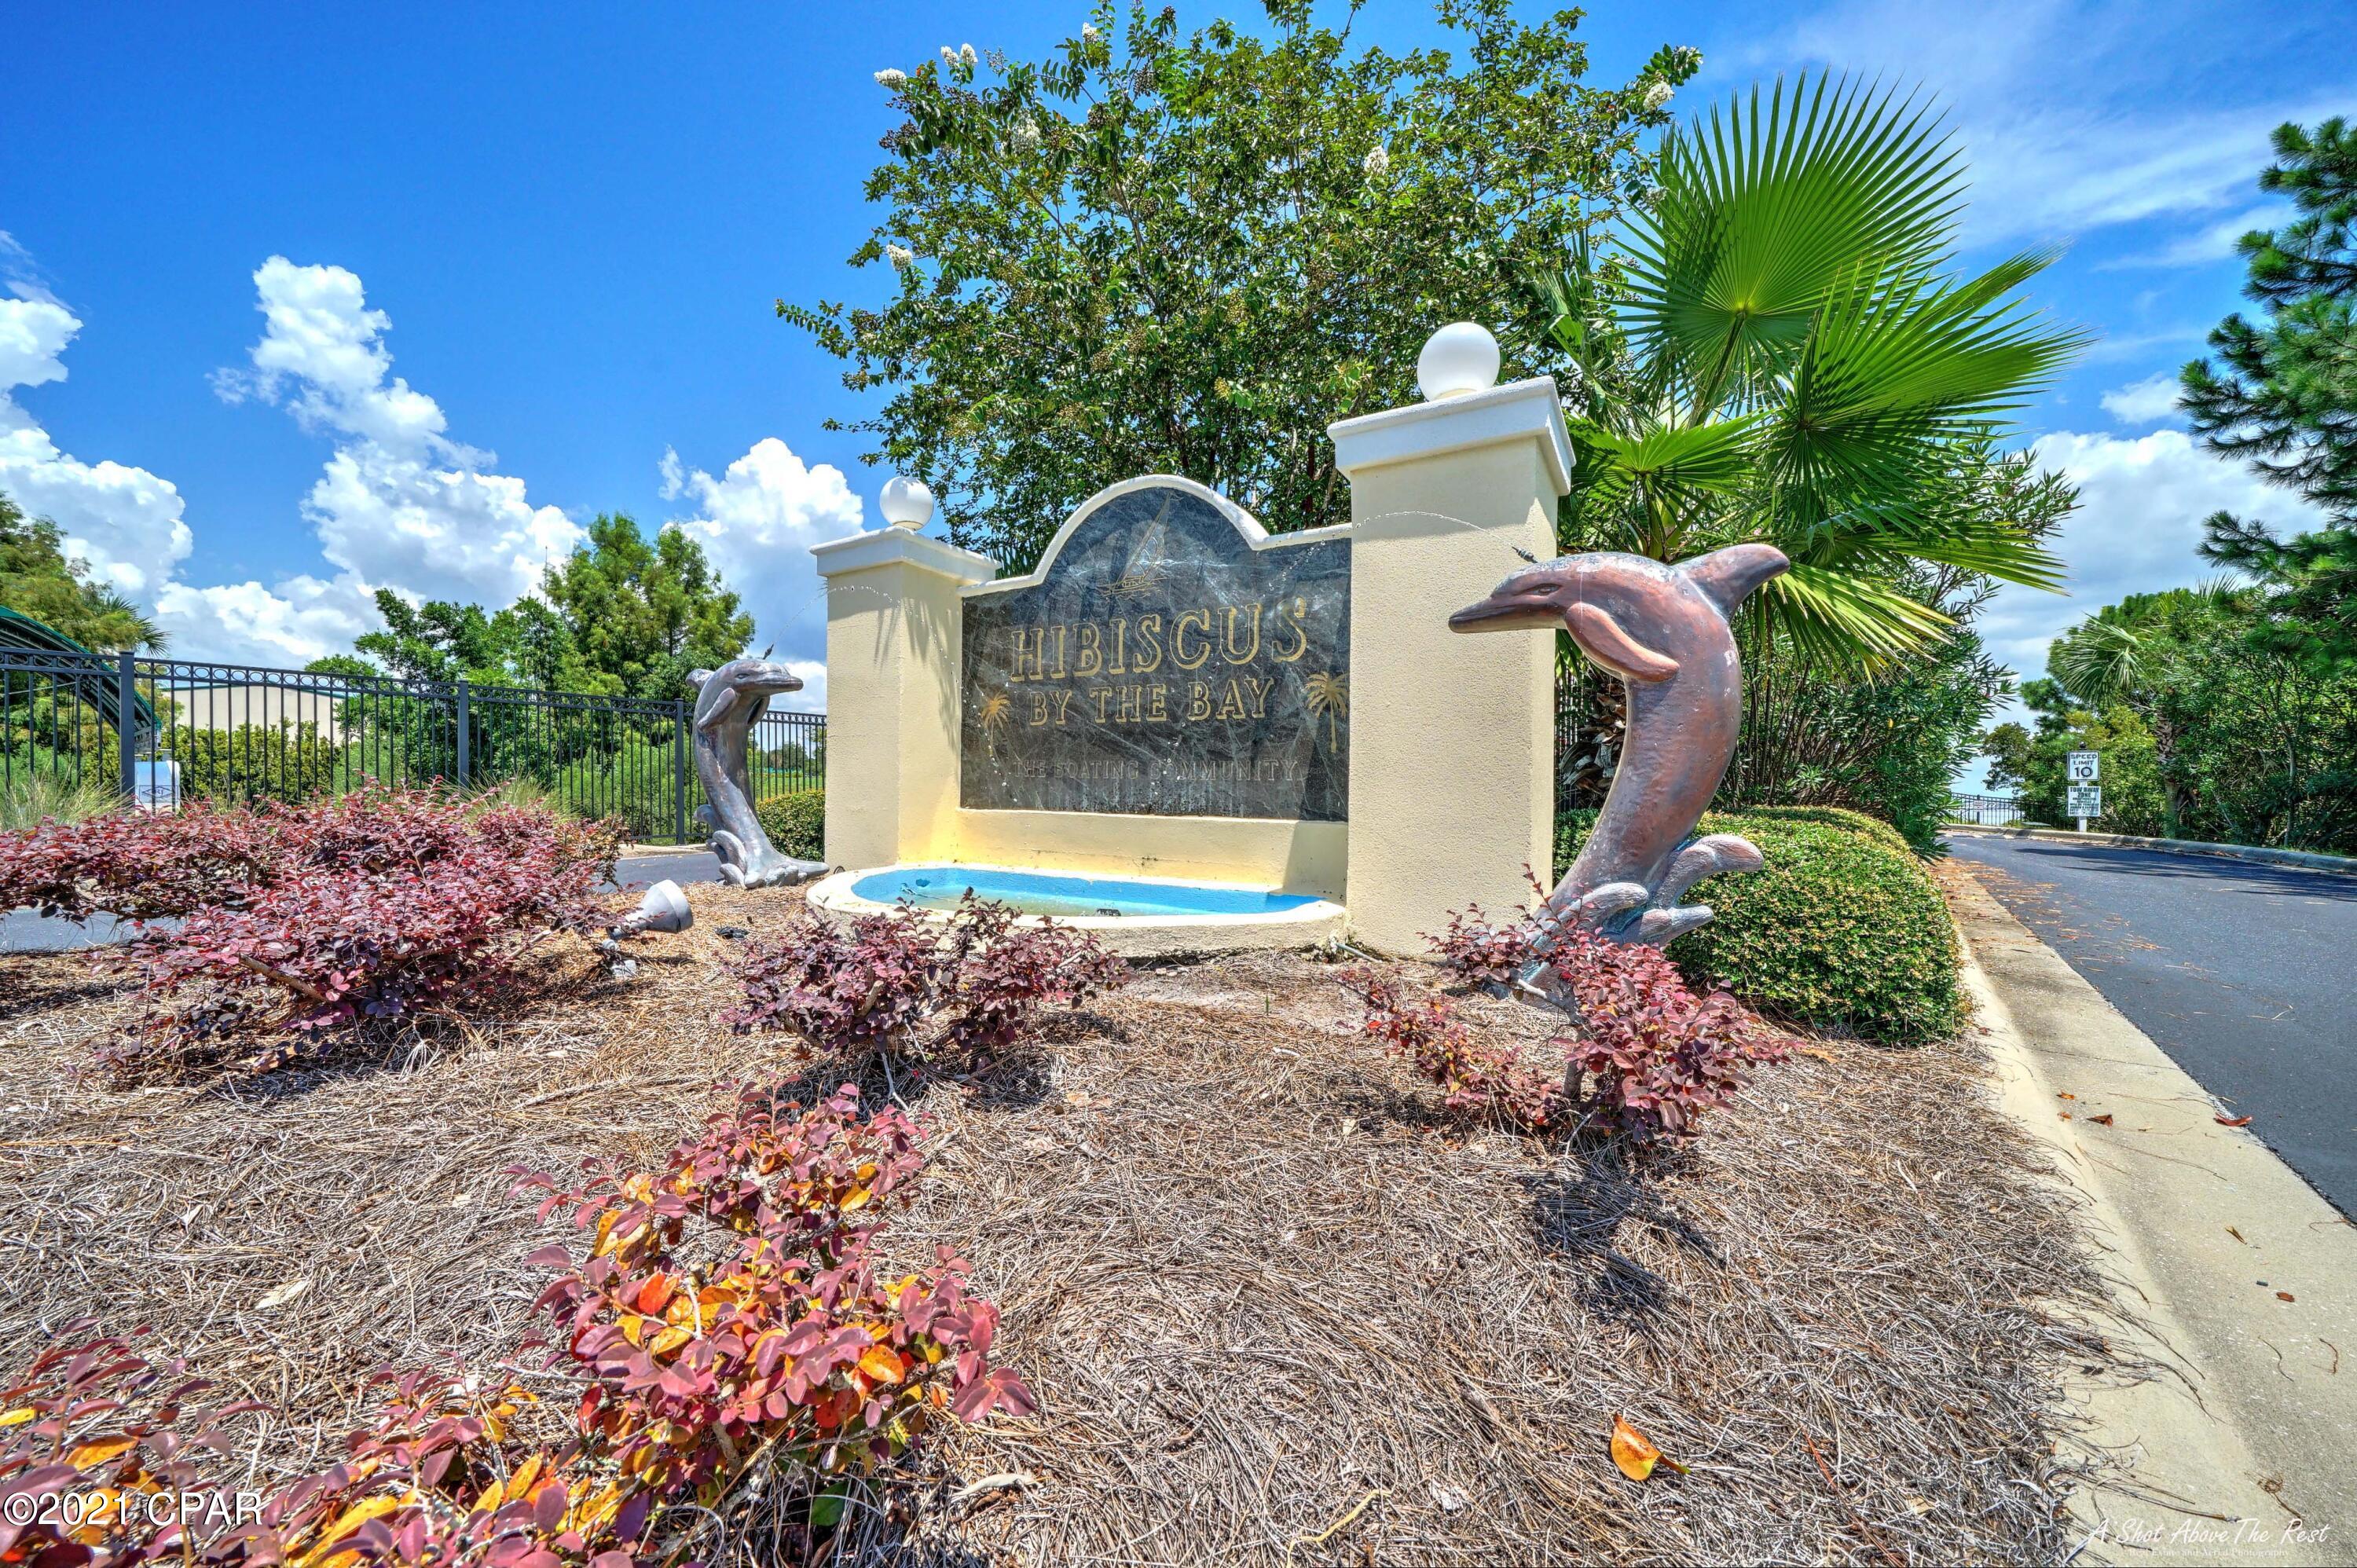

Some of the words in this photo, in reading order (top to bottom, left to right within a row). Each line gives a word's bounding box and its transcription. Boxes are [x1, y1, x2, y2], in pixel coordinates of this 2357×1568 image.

[1011, 597, 1307, 682] HIBISCUS
[1030, 690, 1072, 726] BY
[1090, 684, 1167, 724] THE
[1188, 677, 1274, 720] BAY
[1013, 760, 1047, 778] THE
[1054, 760, 1138, 779] BOATING
[2074, 767, 2094, 777] 10
